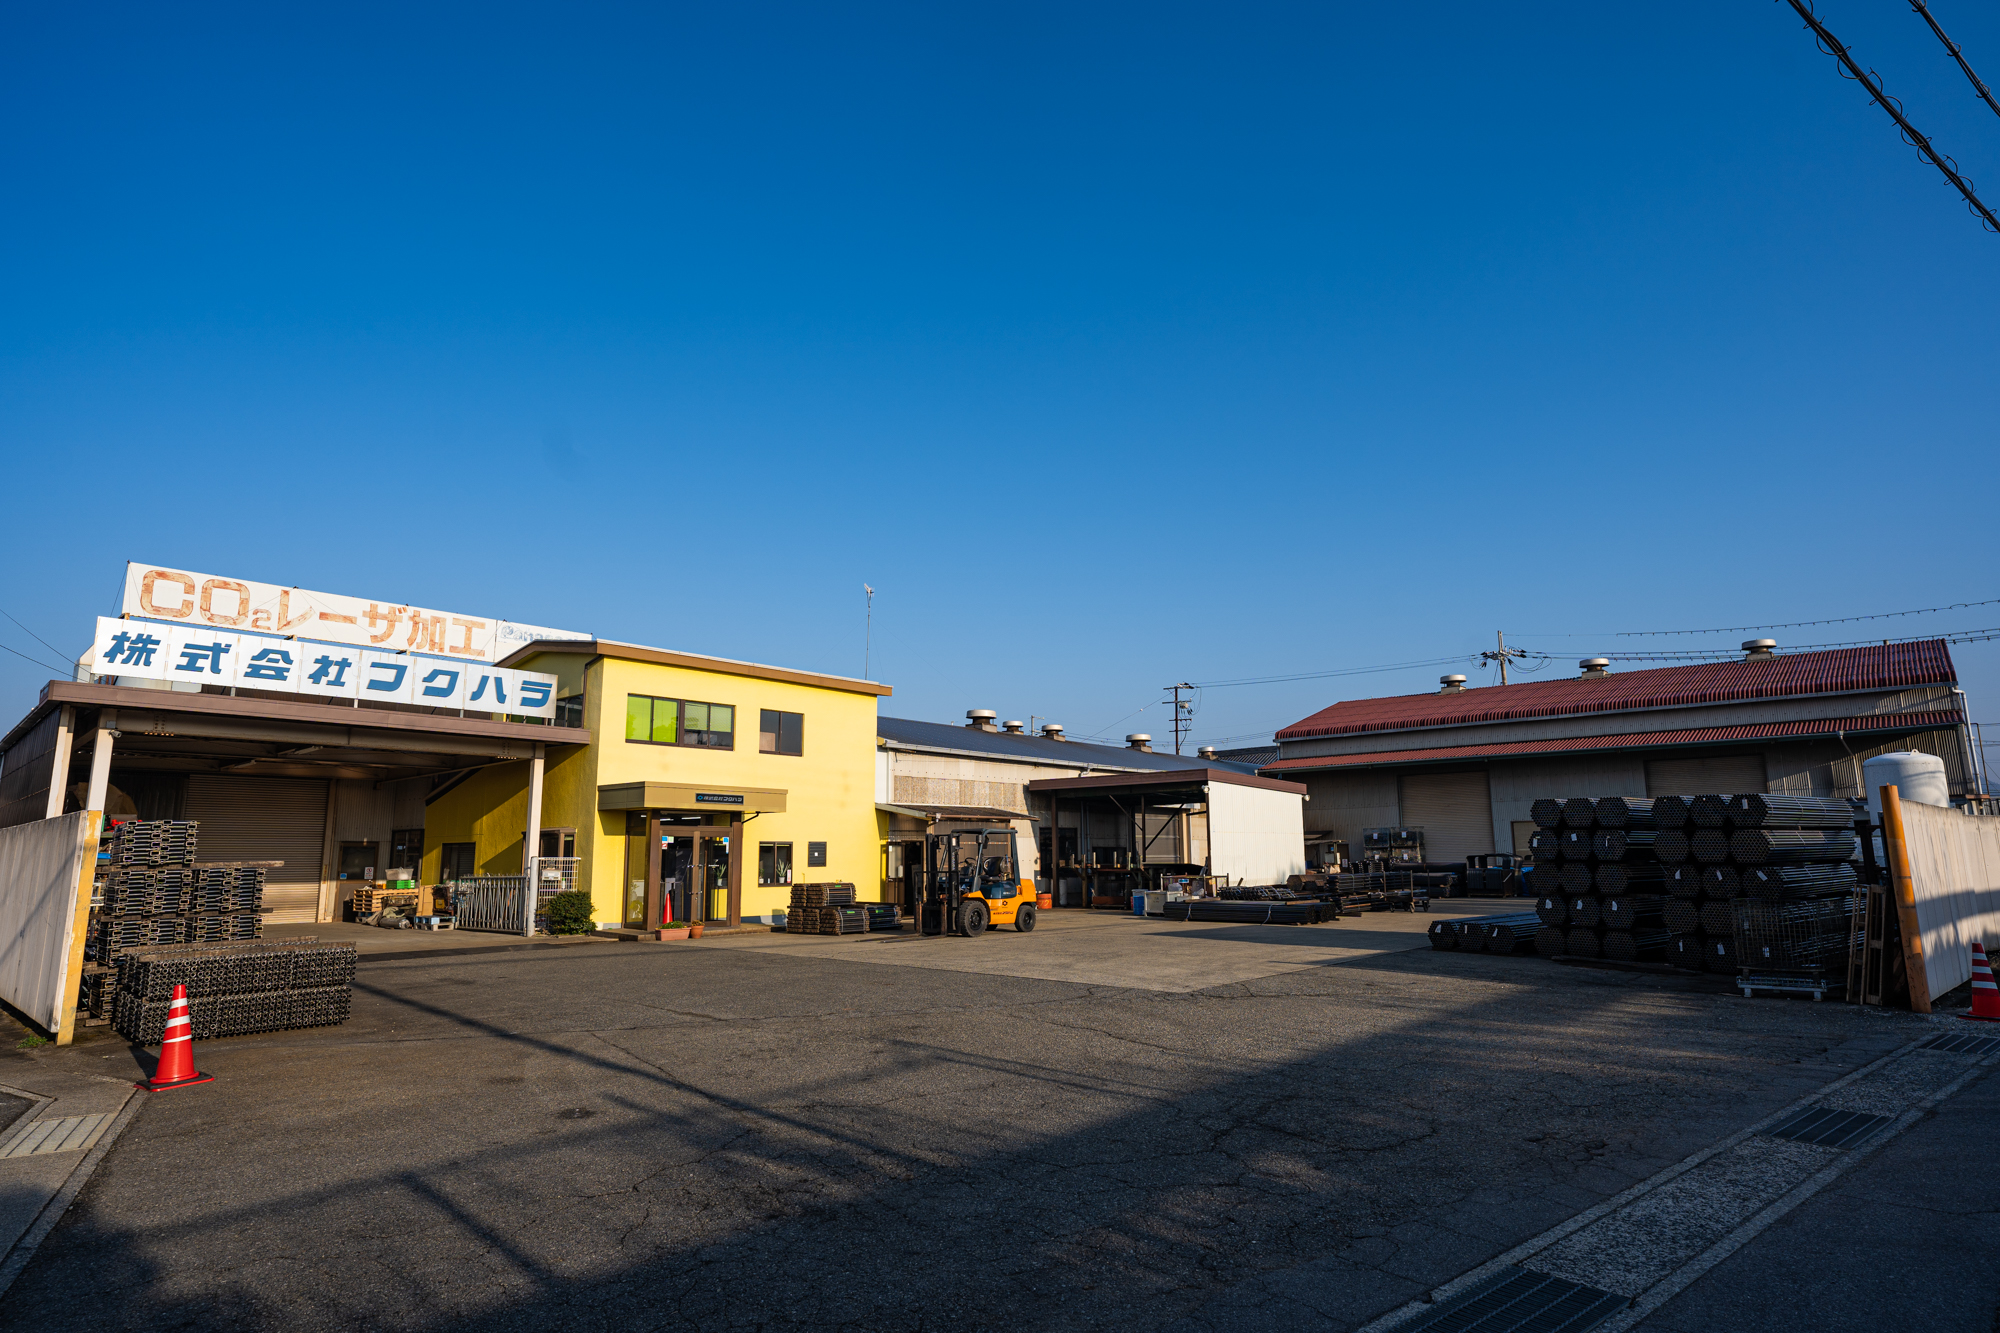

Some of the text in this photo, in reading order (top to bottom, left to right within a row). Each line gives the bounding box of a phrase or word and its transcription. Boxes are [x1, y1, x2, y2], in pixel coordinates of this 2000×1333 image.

[103, 631, 553, 708] 株式会社フクハラ
